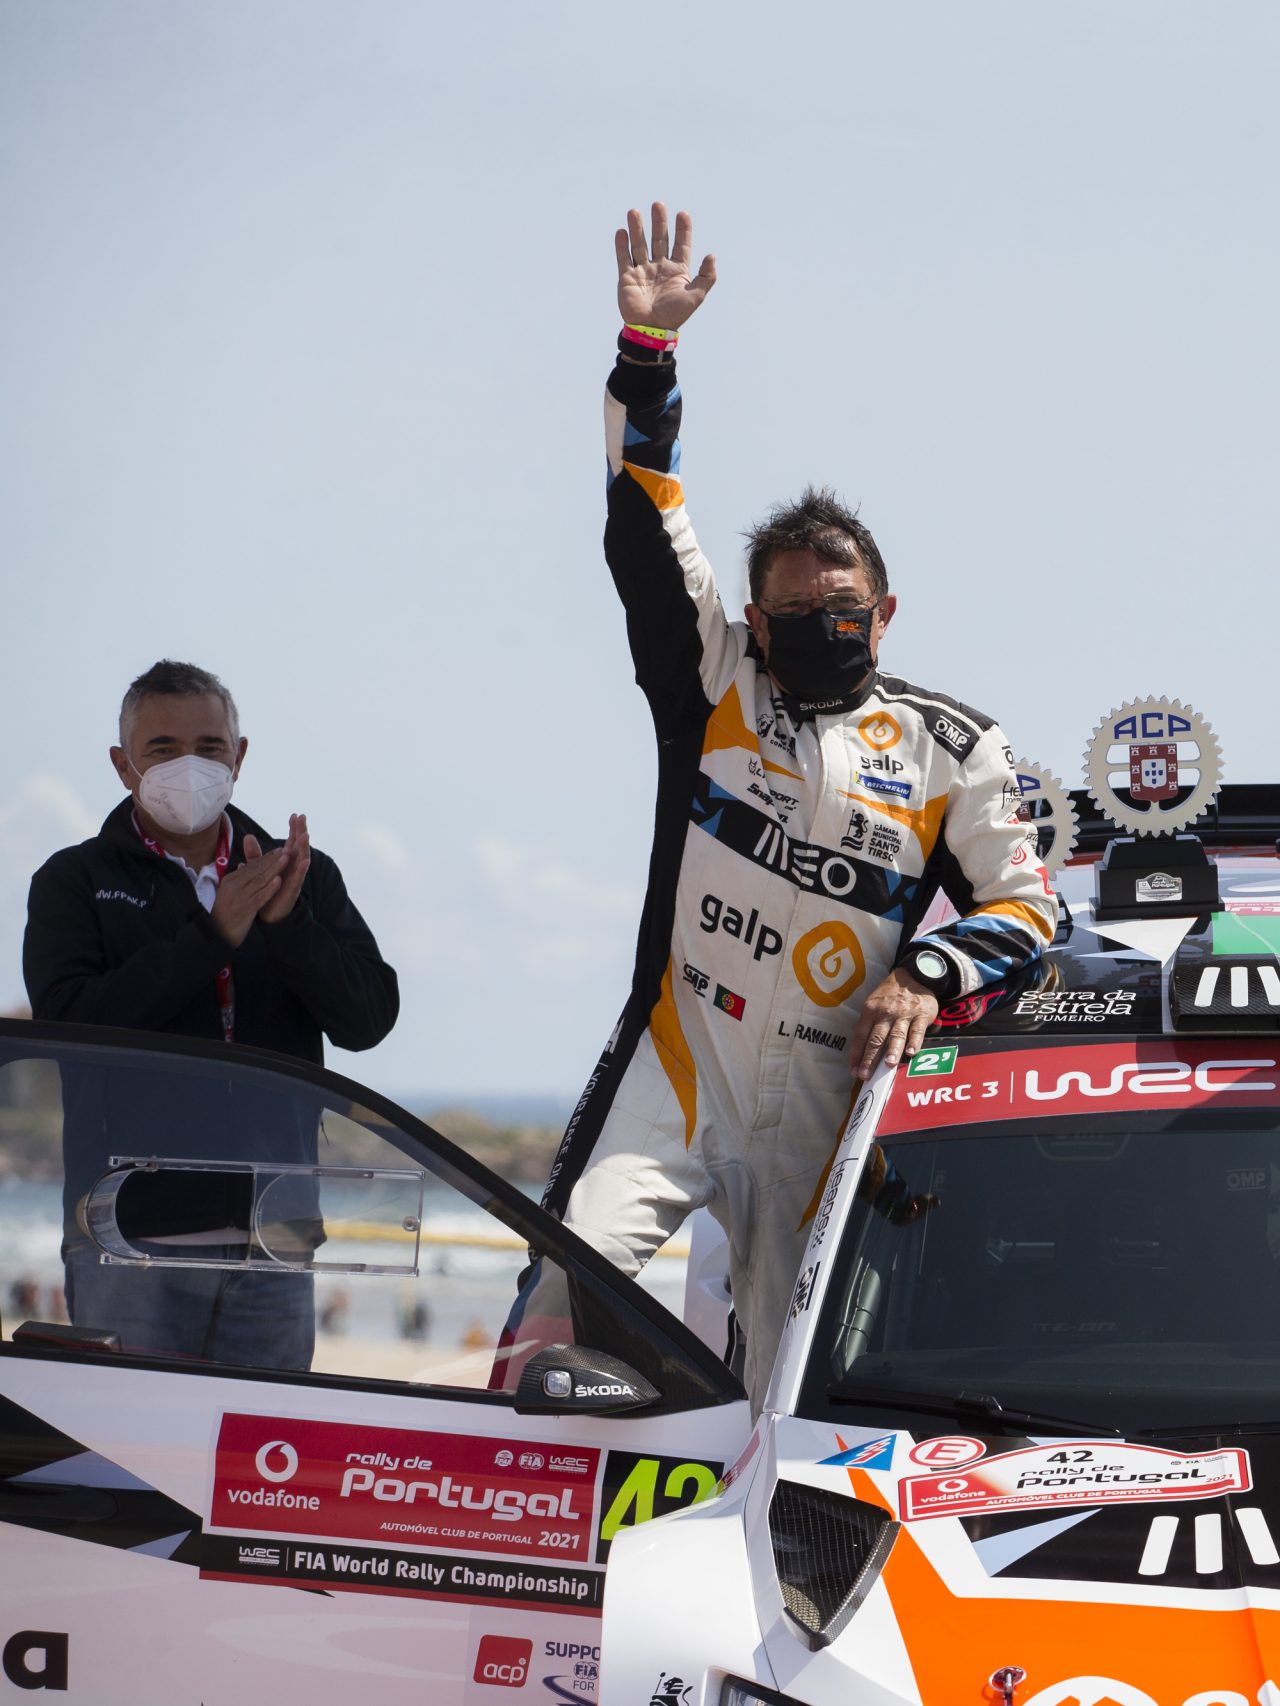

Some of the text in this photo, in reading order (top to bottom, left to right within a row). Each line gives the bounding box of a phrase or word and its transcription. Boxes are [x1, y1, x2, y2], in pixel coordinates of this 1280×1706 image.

[934, 718, 968, 747] OMP
[1114, 712, 1191, 739] ACP
[861, 755, 904, 774] galp
[867, 781, 909, 795] MICHELIN
[869, 838, 899, 854] SANTO
[753, 822, 857, 896] MEO
[700, 894, 783, 962] galp
[1019, 989, 1137, 1001] Serra da
[1013, 1000, 1132, 1015] Estrela
[778, 1021, 847, 1051] L. RAMALHO
[907, 1081, 998, 1107] WRC 3
[1226, 1170, 1266, 1189] OMP
[575, 1385, 633, 1397] ŠKODA
[925, 1443, 961, 1461] E
[1047, 1450, 1094, 1463] 42
[346, 1453, 433, 1470] rally de
[520, 1455, 541, 1468] FIA
[549, 1455, 590, 1468] WRC
[1021, 1464, 1125, 1476] rally de
[1017, 1469, 1206, 1489] Portugal
[1206, 1474, 1233, 1483] 2021
[227, 1488, 320, 1510] vodafone
[340, 1468, 580, 1522] Portugal
[920, 1490, 986, 1503] vodafone
[986, 1488, 1162, 1505] AUTOMÓVEL CLUB DE PORTUGAL
[380, 1521, 533, 1544] AUTOMÓVEL CLUB DE PORTUGAL
[537, 1531, 580, 1549] 2021
[239, 1546, 280, 1557] WRC
[294, 1551, 326, 1571] FIA
[333, 1554, 389, 1577] World
[395, 1560, 445, 1585] Rally
[451, 1565, 589, 1599] Championship
[2, 1630, 69, 1691] a
[483, 1663, 526, 1683] acp
[575, 1664, 598, 1677] FIA
[573, 1680, 595, 1691] FOR
